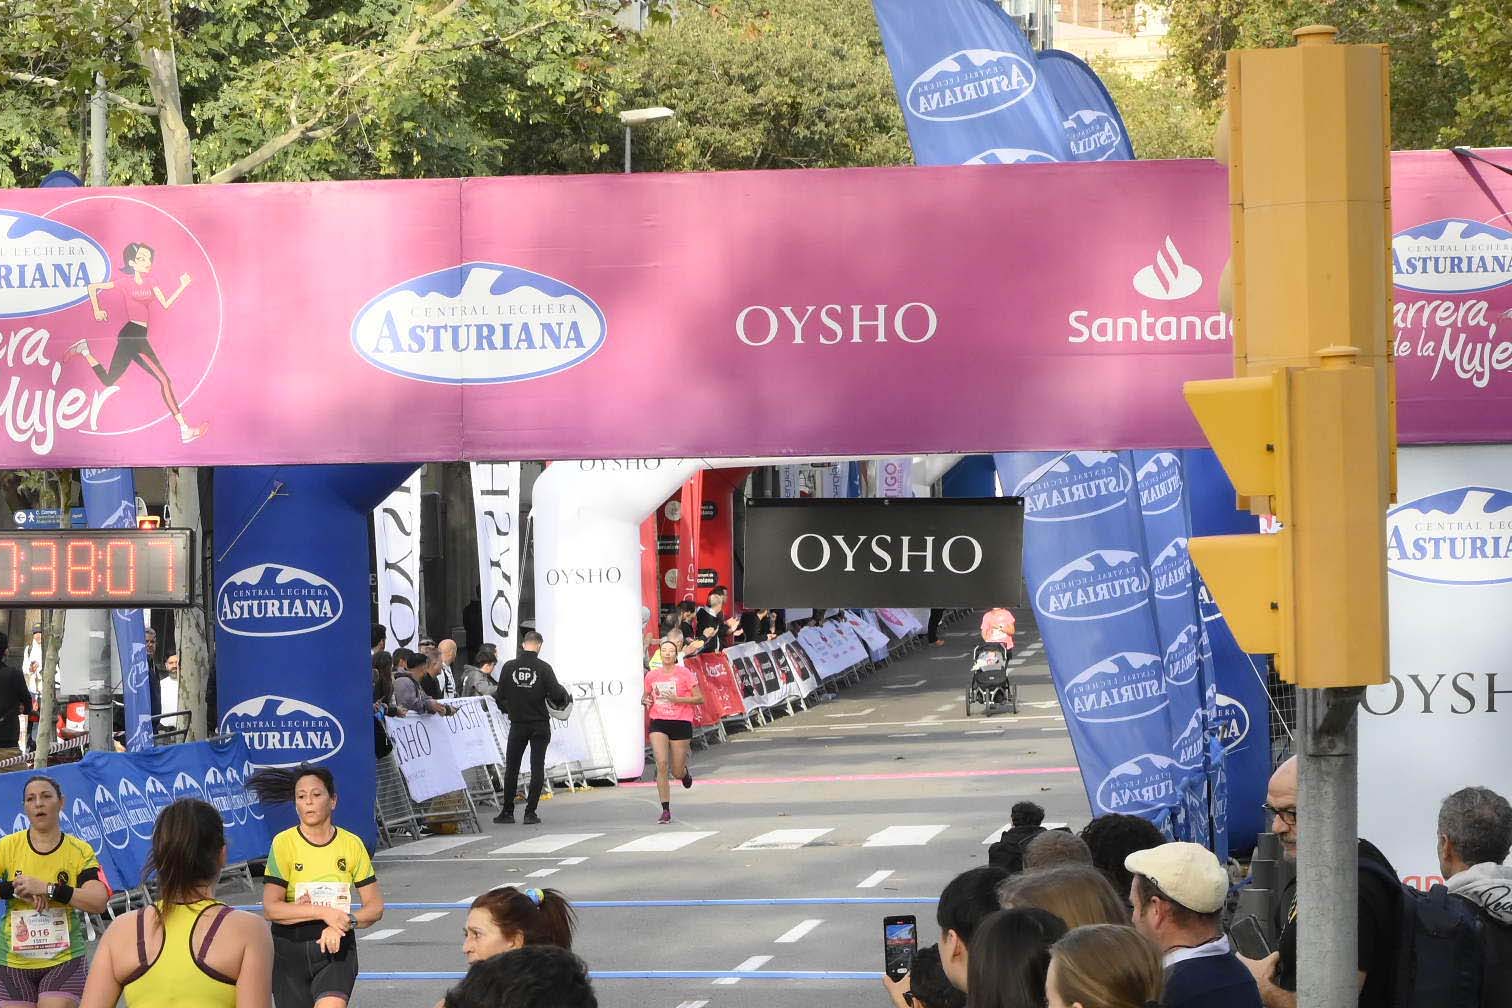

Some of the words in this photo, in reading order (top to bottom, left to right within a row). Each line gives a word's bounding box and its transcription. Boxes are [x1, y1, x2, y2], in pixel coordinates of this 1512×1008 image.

[13, 246, 87, 257] LECHERA
[1407, 244, 1459, 252] CENTRAL
[410, 305, 489, 318] CENTRAL
[496, 303, 579, 316] LECHERA
[1394, 299, 1489, 328] arrera
[372, 308, 586, 355] ASTURIANA
[735, 302, 938, 347] OYSHO
[1417, 328, 1435, 356] la
[1415, 521, 1481, 530] CENTRAL
[790, 533, 983, 574] OYSHO
[546, 566, 621, 586] OYSHO
[233, 589, 276, 597] CENTRAL
[280, 588, 329, 597] LECHERA
[221, 593, 334, 621] ASTURIANA
[519, 671, 531, 681] BP
[235, 720, 276, 729] CENTRAL
[281, 719, 330, 728] LECHERA
